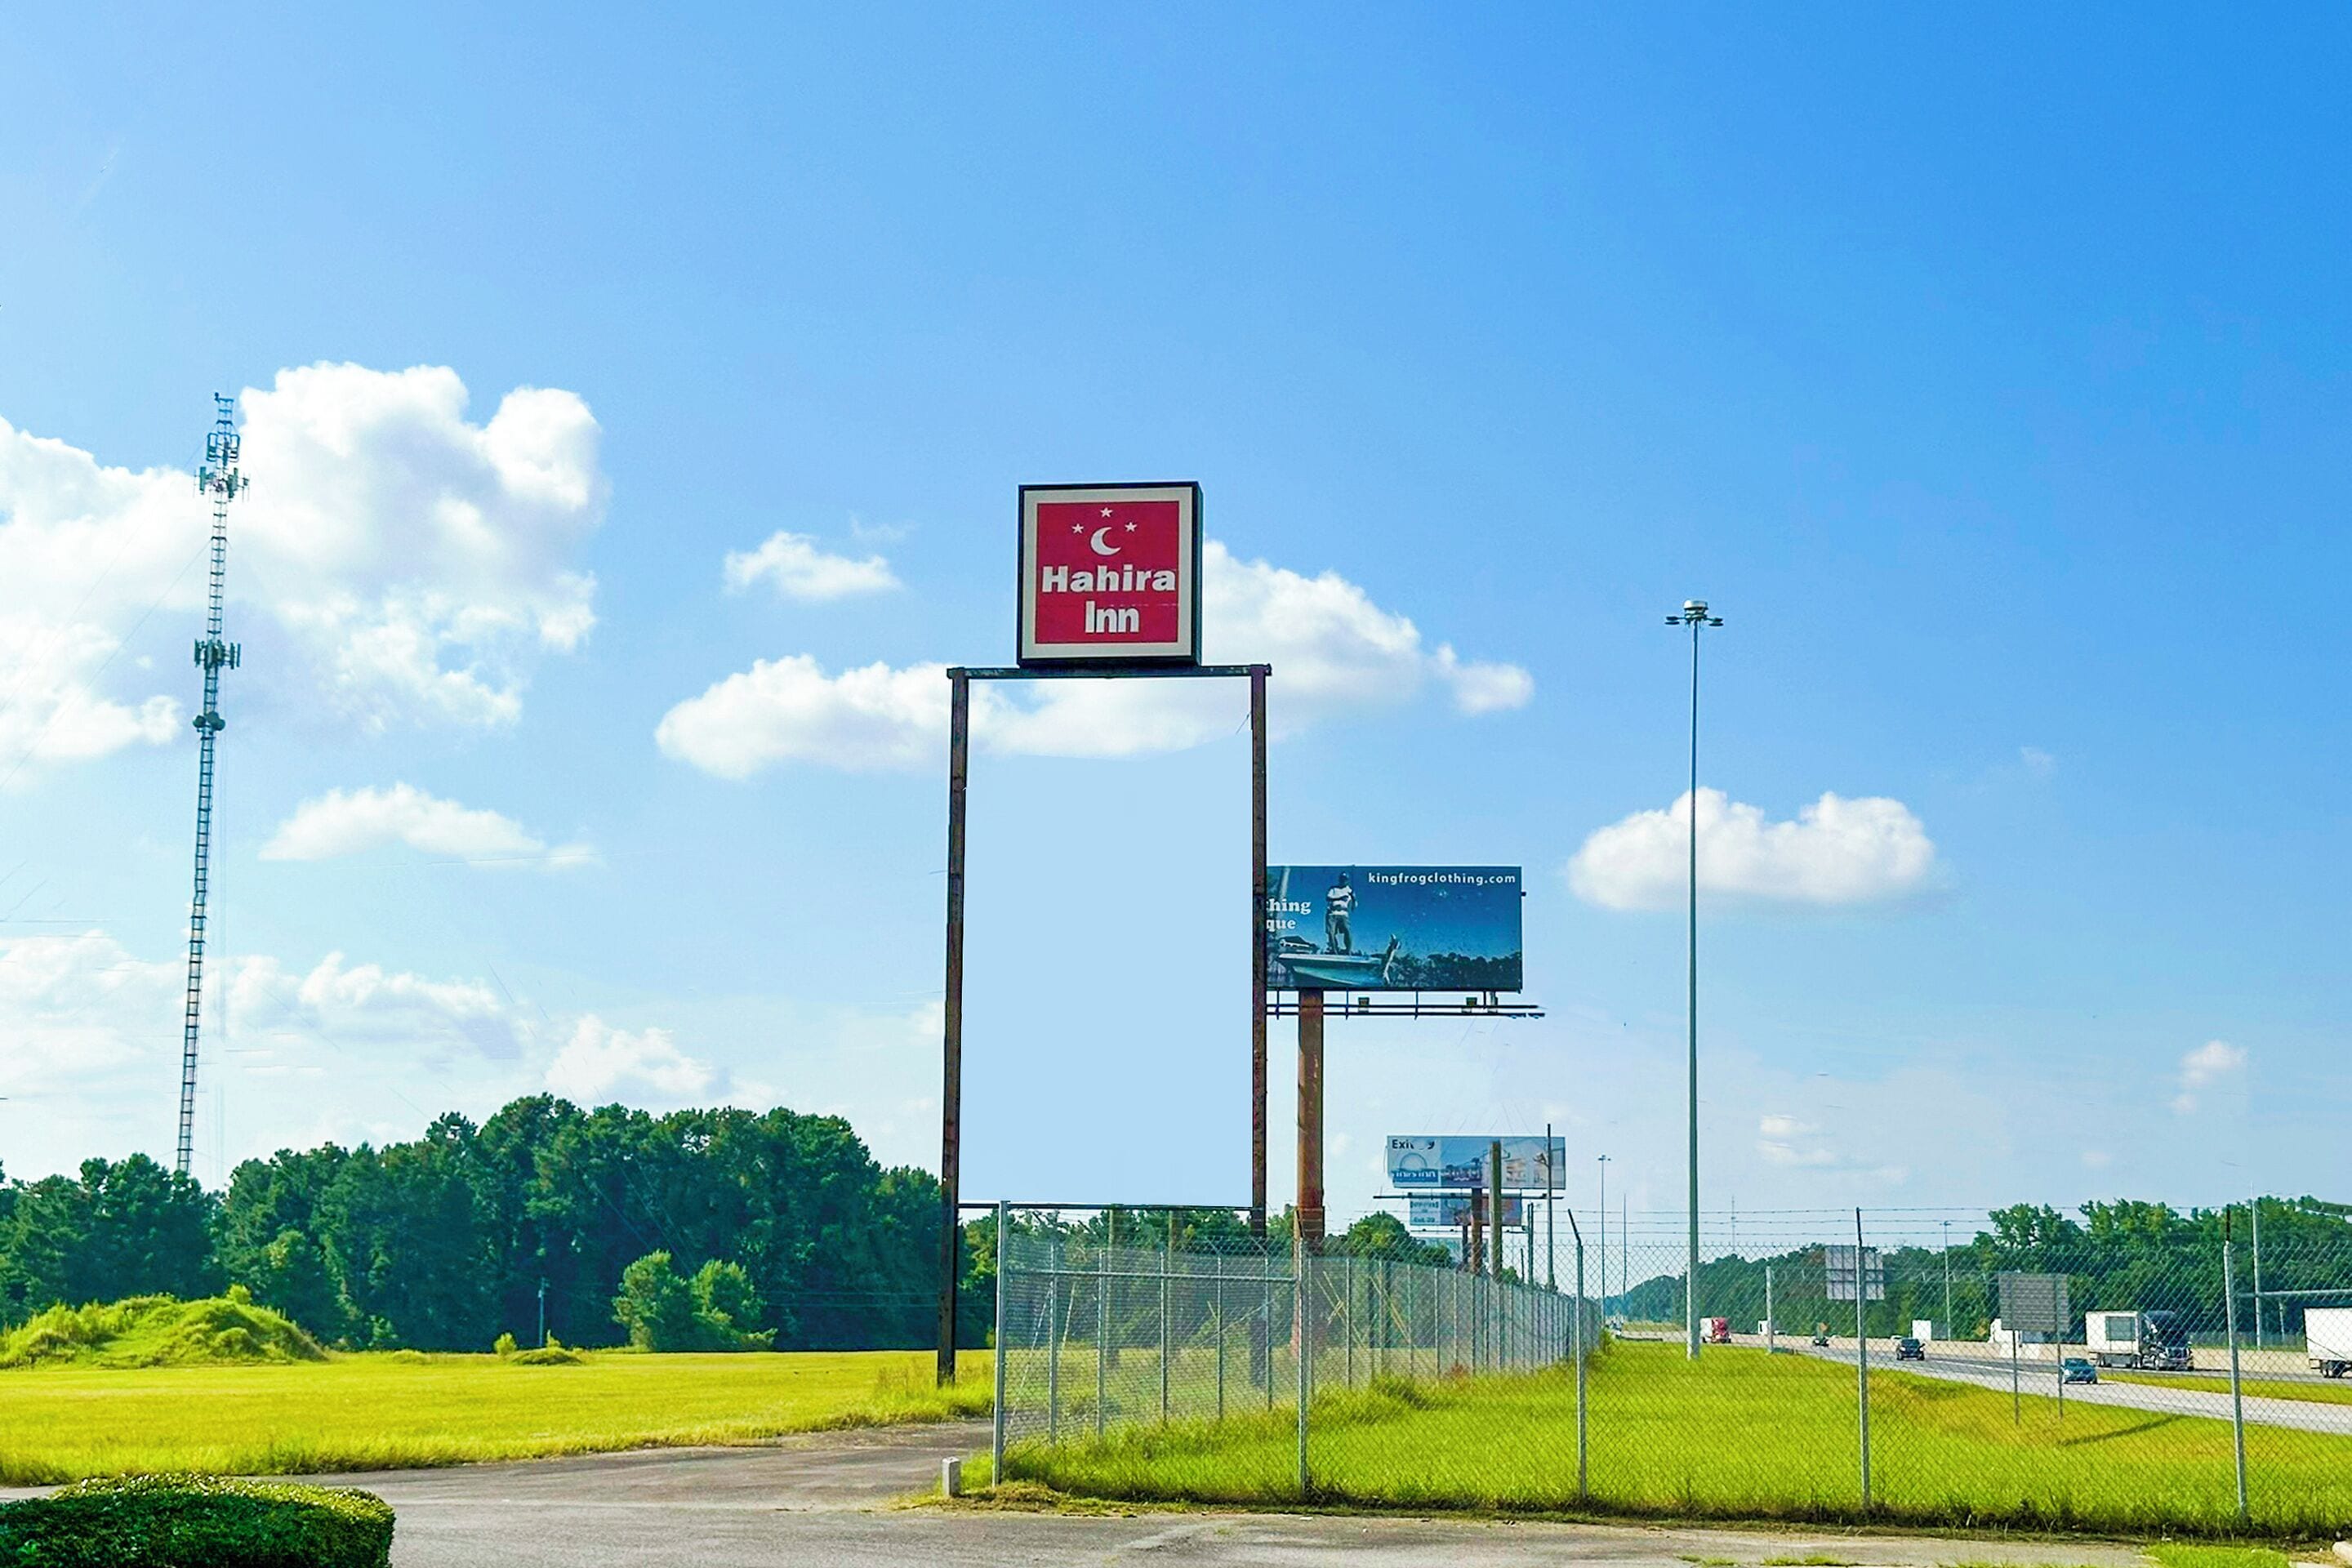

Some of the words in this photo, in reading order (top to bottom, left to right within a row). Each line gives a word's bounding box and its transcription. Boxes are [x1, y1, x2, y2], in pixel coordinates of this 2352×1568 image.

[1041, 564, 1176, 592] Hahira
[1085, 601, 1139, 633] Inn
[1368, 872, 1516, 886] kingfrogclothing.com
